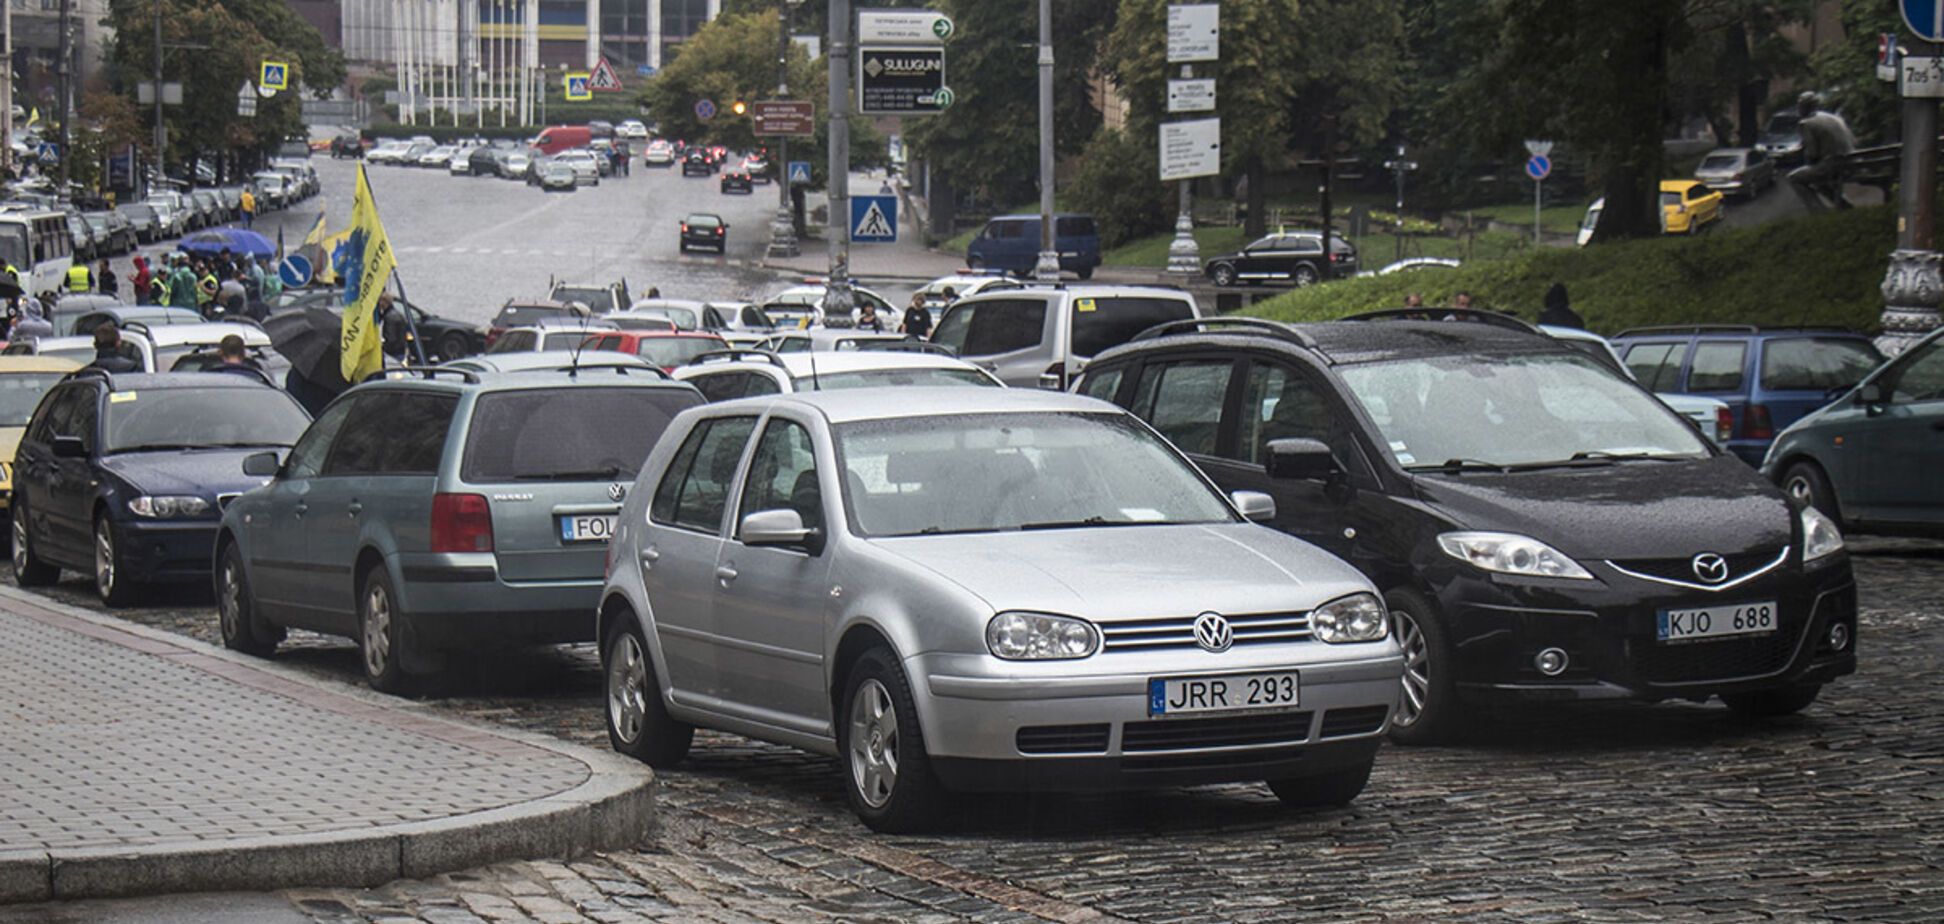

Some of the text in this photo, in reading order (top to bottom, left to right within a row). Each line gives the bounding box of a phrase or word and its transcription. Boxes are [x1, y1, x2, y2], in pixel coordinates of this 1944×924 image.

[883, 59, 941, 71] SULUGUNI
[577, 518, 612, 537] FOL
[1670, 611, 1711, 636] KJO
[1733, 606, 1770, 630] 688
[1170, 681, 1228, 709] JRR
[1247, 676, 1294, 705] 293
